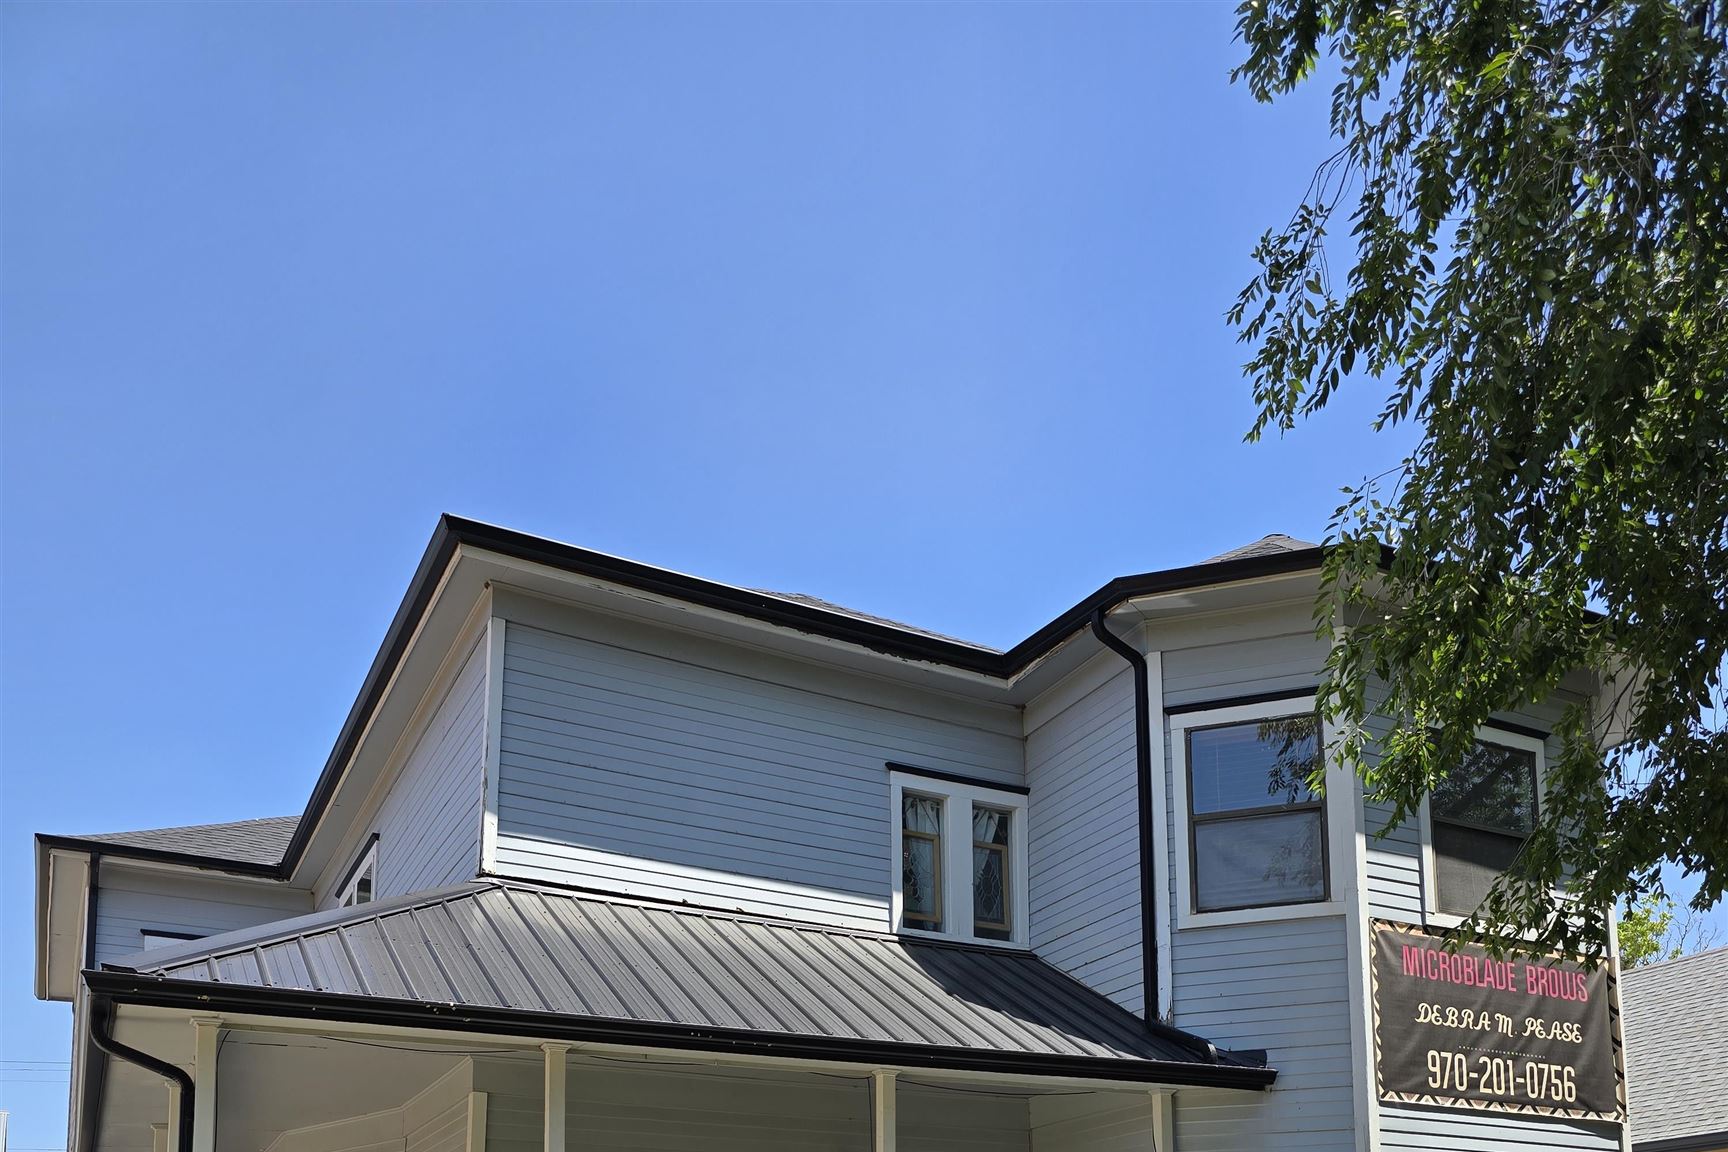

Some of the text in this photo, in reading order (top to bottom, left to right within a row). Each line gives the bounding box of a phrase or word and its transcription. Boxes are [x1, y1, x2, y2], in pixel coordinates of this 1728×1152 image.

[1402, 945, 1589, 1002] MICROBLADE BROWS
[1415, 1002, 1583, 1044] DEBRA M. PEASE
[1427, 1050, 1577, 1102] 970-201-0756
